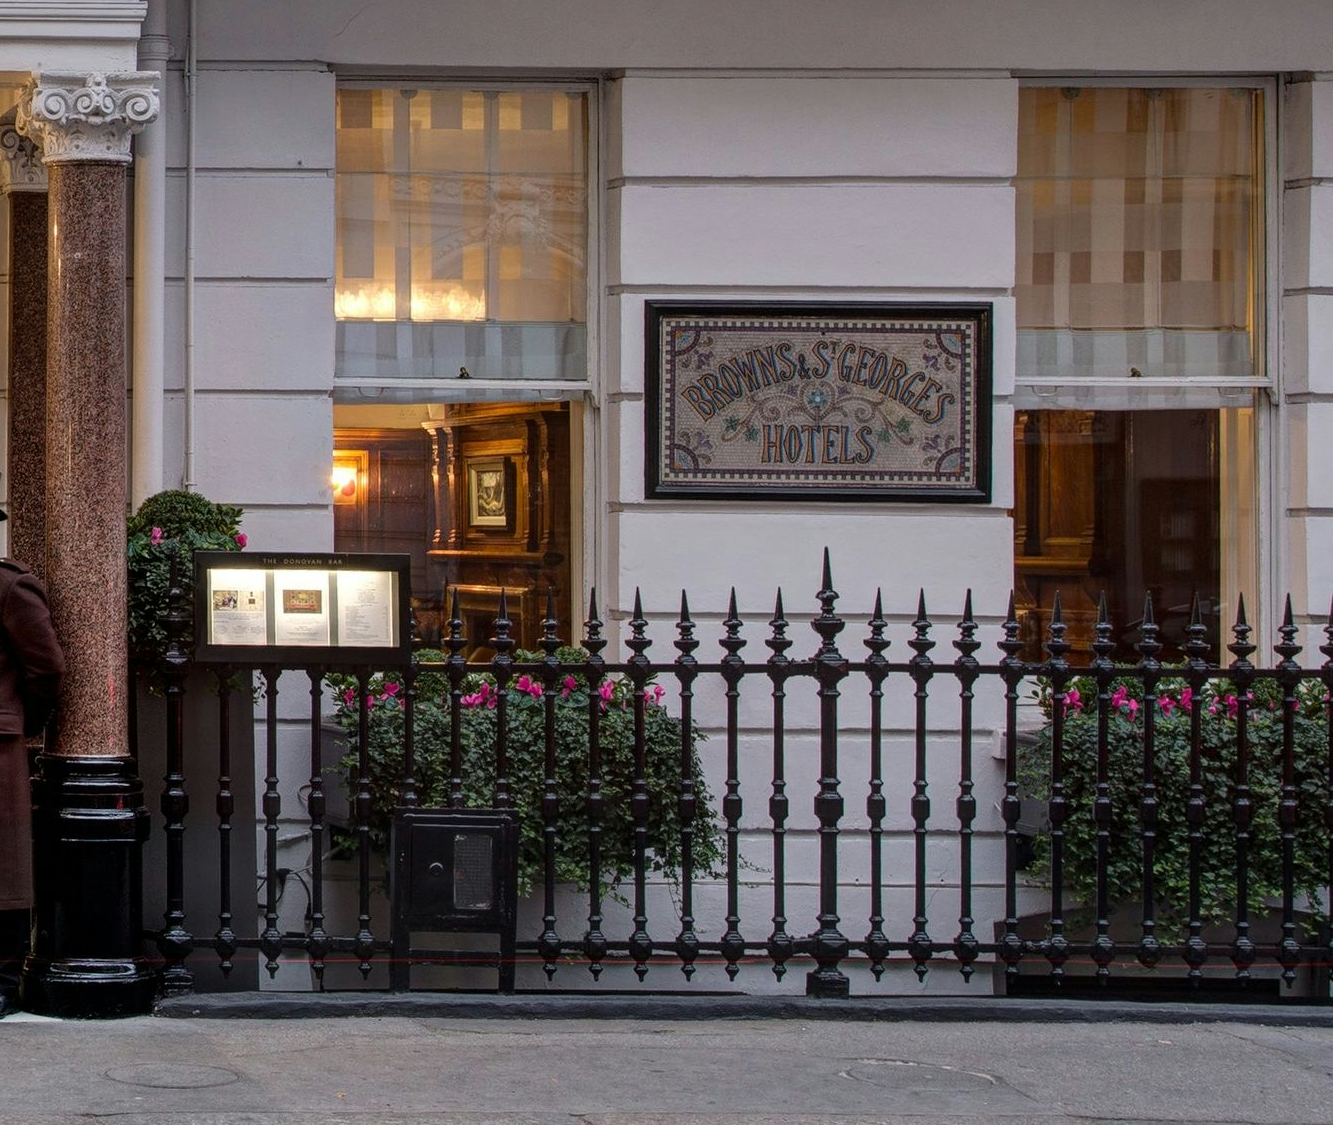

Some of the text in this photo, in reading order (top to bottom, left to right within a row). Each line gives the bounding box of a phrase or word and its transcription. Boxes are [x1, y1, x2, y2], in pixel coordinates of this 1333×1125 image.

[680, 341, 800, 423] BROWNS
[798, 352, 813, 380] &
[836, 343, 957, 425] GEORGES
[761, 423, 876, 465] HOTELS
